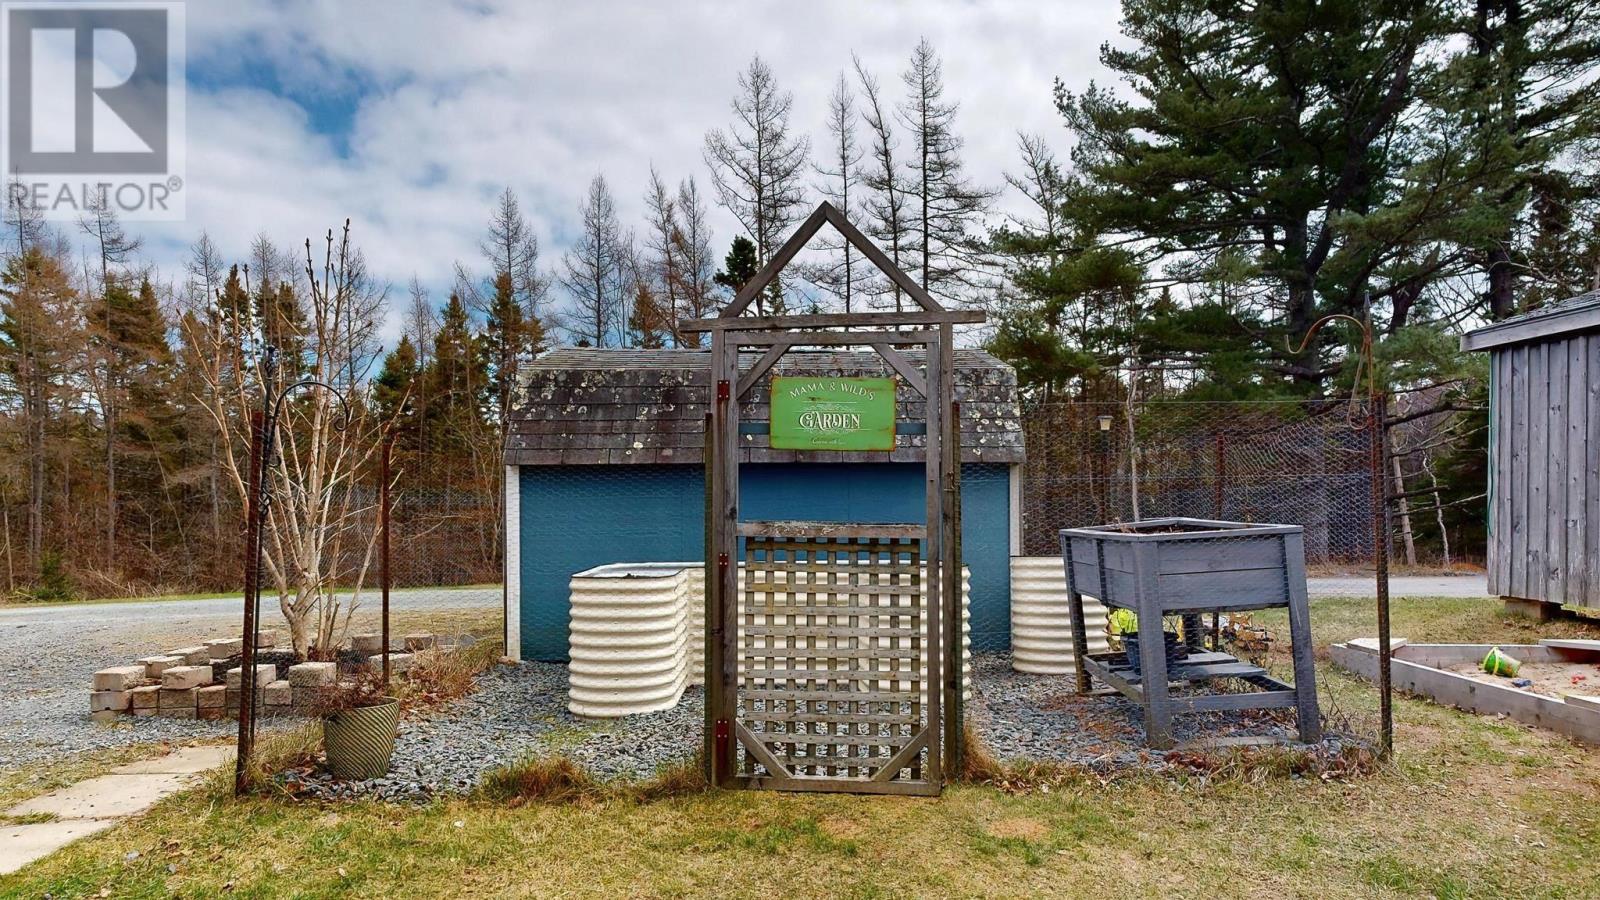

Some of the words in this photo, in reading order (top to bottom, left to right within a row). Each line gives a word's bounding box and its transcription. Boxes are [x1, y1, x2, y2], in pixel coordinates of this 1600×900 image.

[789, 382, 824, 399] MAMA
[829, 381, 836, 392] &
[840, 382, 876, 401] WILD'S
[799, 411, 860, 431] GARDEN
